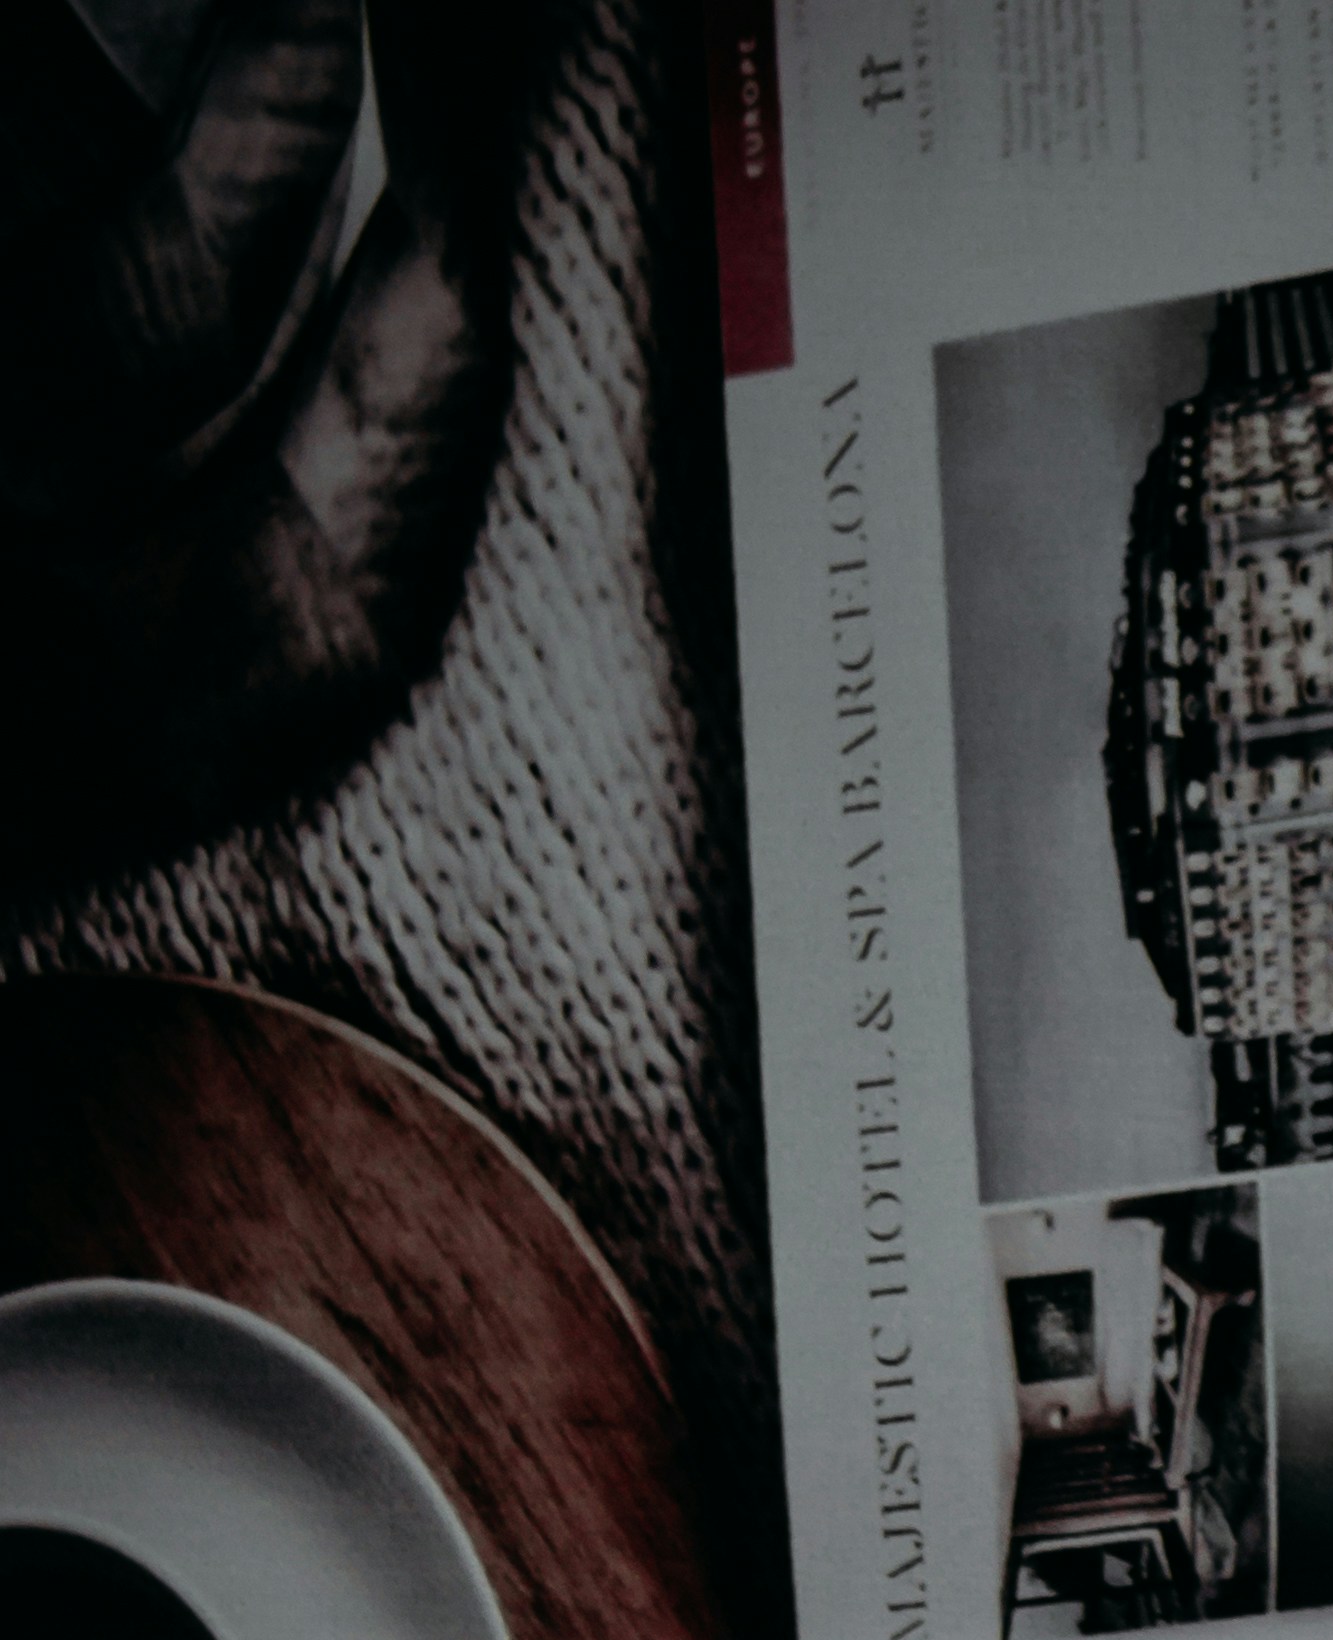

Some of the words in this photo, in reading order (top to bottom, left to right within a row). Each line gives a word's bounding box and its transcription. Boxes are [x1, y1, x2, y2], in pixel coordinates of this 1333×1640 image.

[736, 31, 767, 180] EUROPE
[820, 374, 884, 813] BARCELONA
[843, 837, 891, 962] SPA
[852, 985, 895, 1032] &
[852, 1046, 908, 1301] HOTEL
